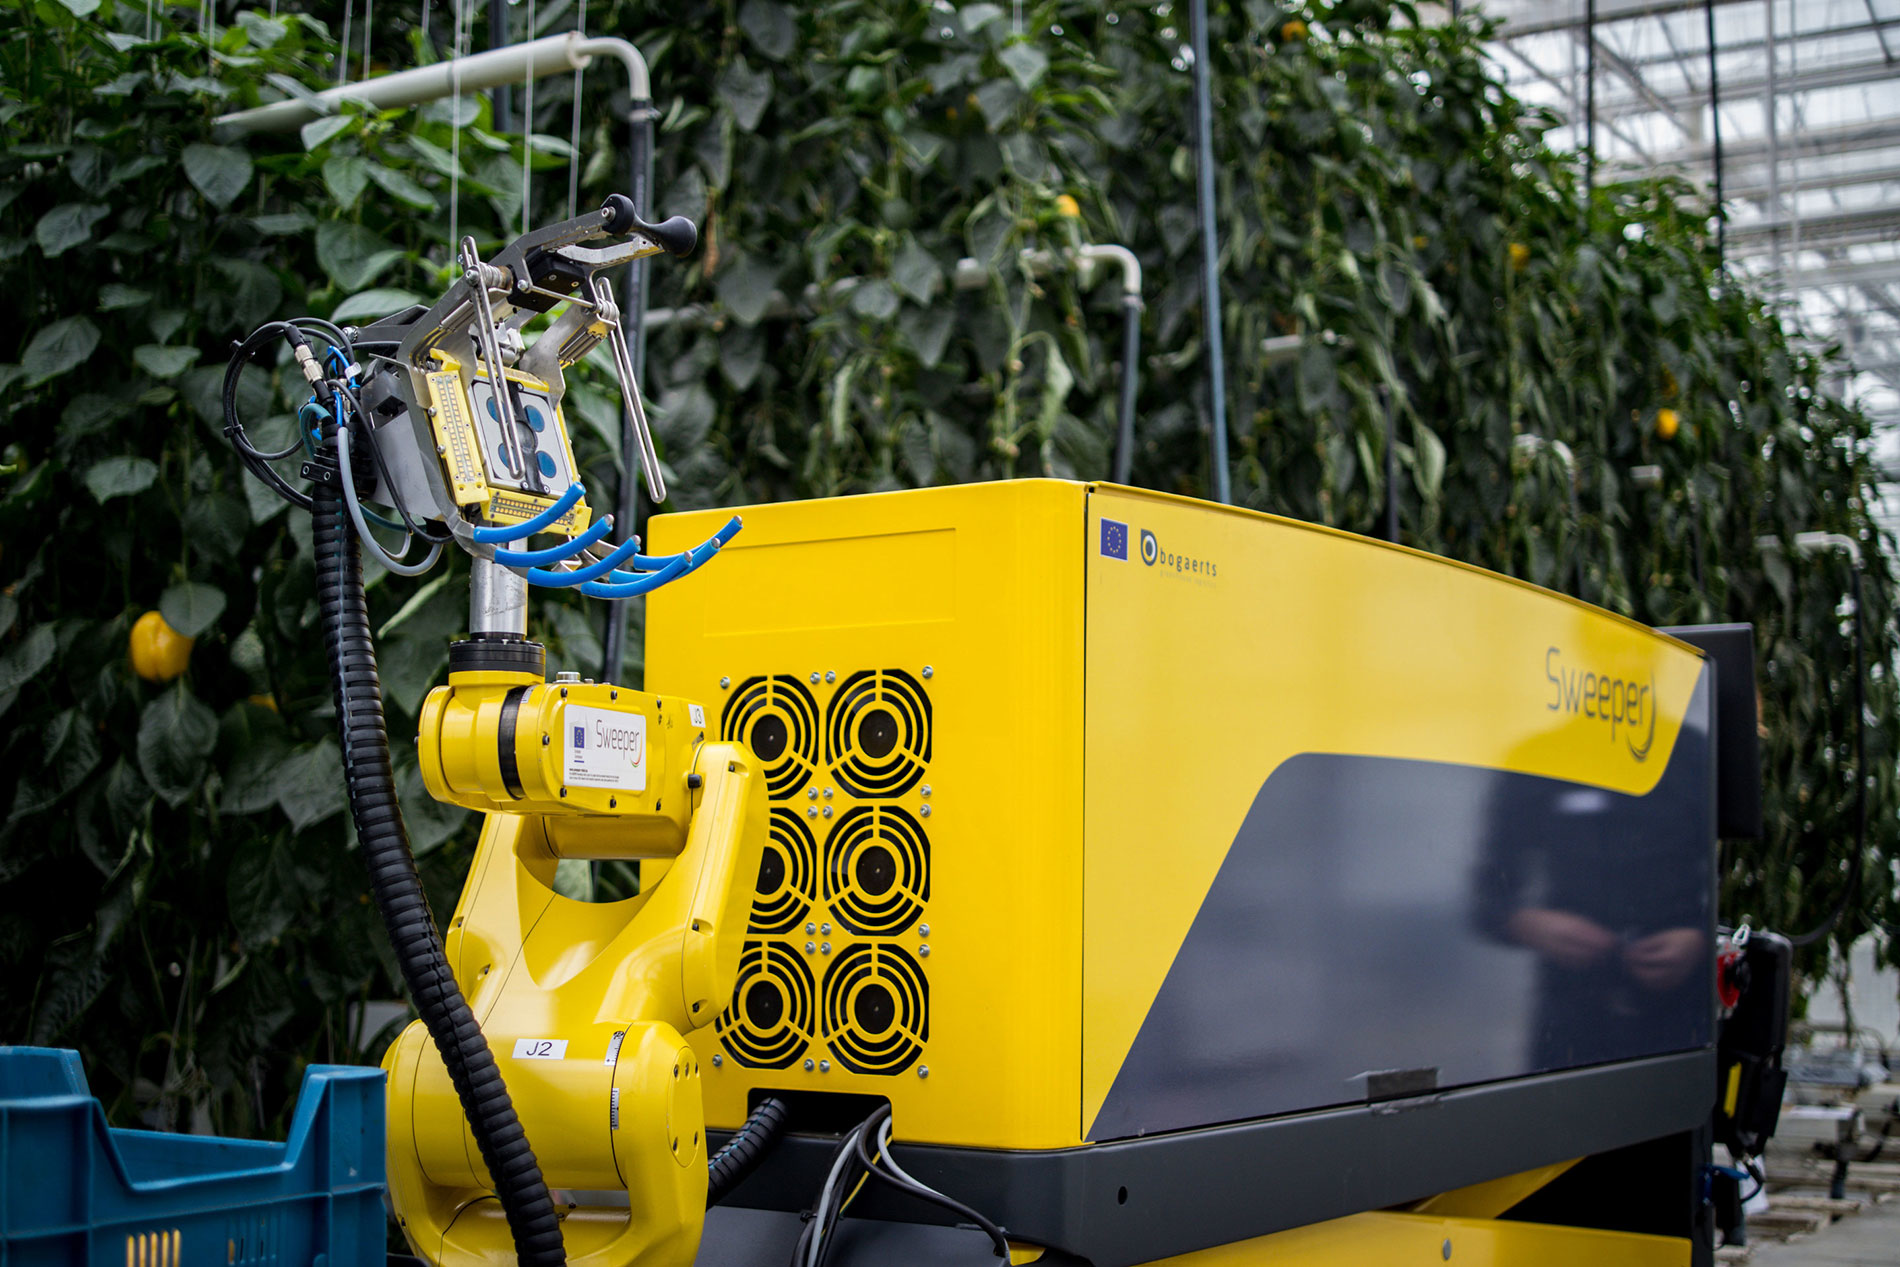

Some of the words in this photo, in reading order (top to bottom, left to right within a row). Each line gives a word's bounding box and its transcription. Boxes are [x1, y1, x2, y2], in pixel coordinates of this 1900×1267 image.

[1160, 547, 1217, 577] bogaerts
[1545, 645, 1649, 742] Sweeper
[596, 719, 640, 760] Sweeper
[526, 1041, 553, 1056] J2
